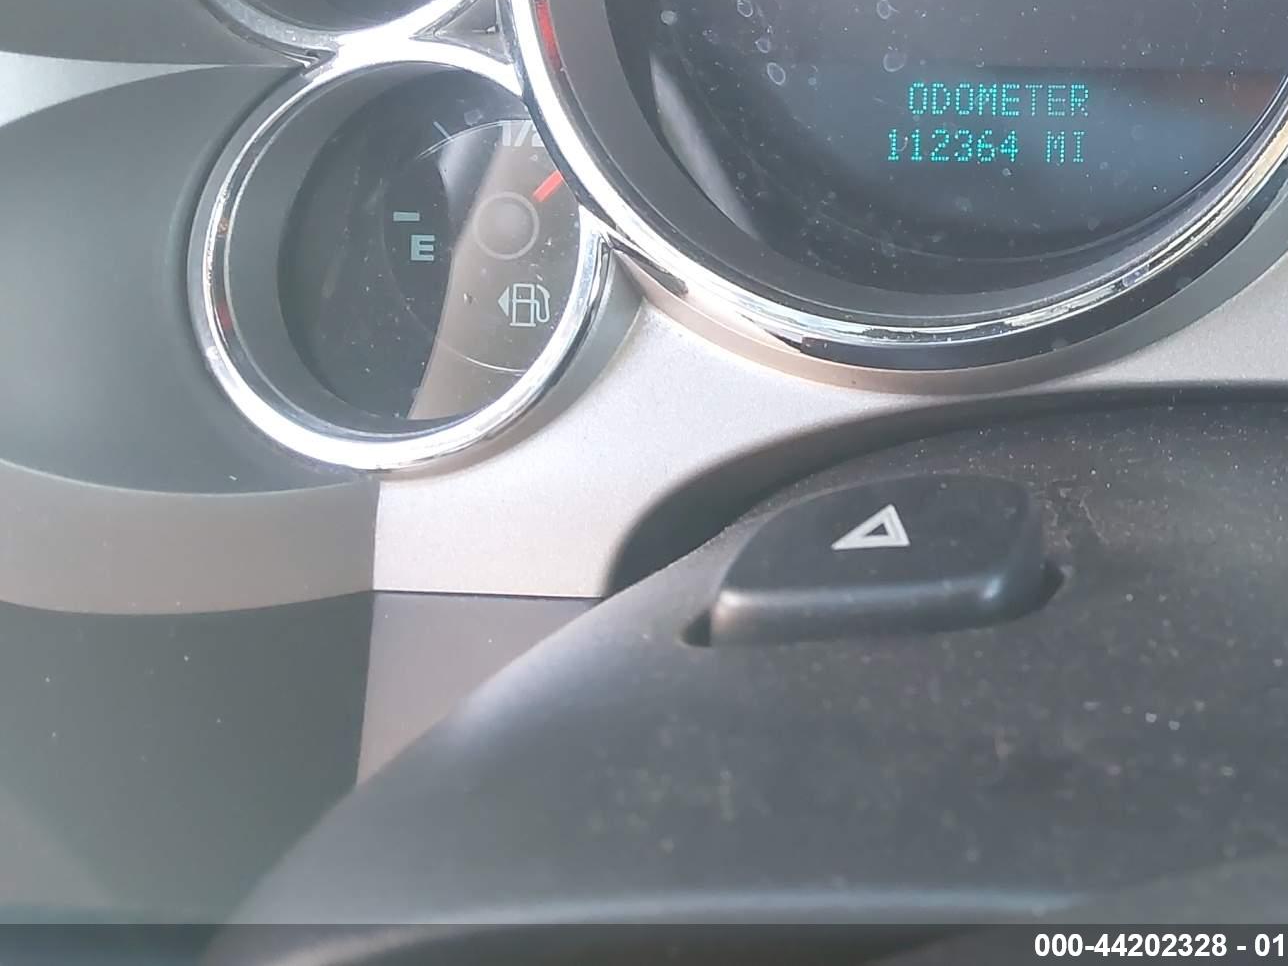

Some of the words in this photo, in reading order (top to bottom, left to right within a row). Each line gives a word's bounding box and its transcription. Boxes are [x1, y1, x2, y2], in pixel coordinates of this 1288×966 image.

[908, 82, 1089, 117] ODOMETER
[887, 129, 1019, 163] 112364
[1046, 131, 1086, 163] MI
[410, 235, 435, 261] E
